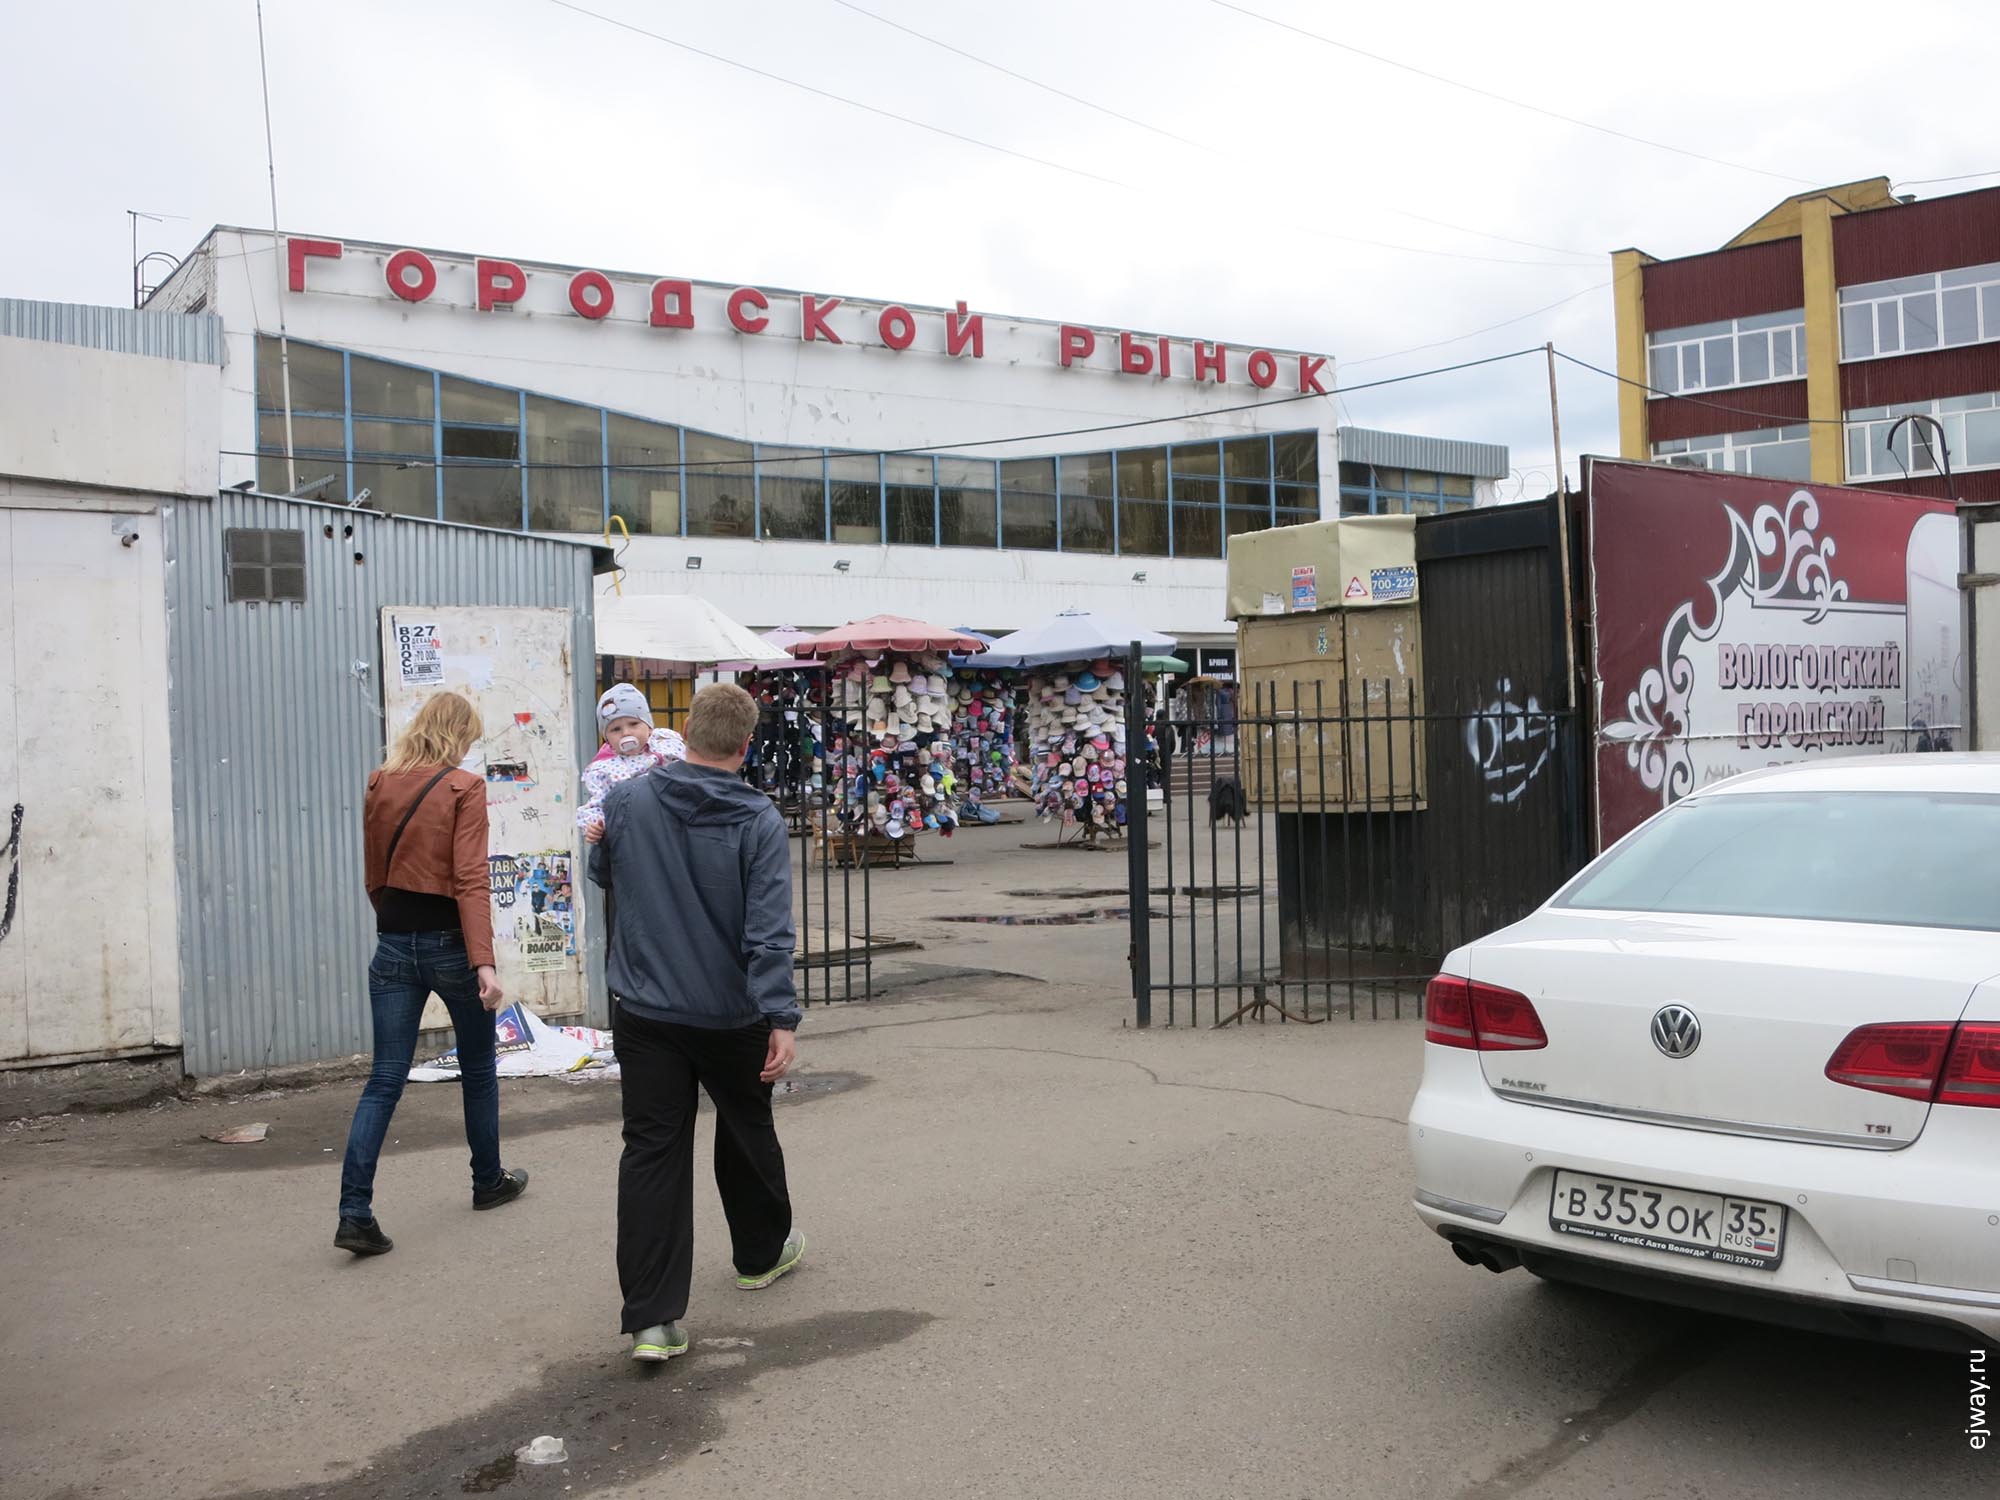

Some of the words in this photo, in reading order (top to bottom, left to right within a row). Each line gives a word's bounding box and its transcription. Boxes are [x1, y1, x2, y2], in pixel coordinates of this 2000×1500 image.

[286, 235, 984, 359] ГОРОДСКОЙ
[1059, 323, 1328, 395] РЫНОК
[1372, 577, 1415, 591] 700-222
[413, 625, 436, 637] 27
[400, 626, 413, 675] ВОЛОСЫ
[1718, 640, 1901, 694] ВОЛОГОДСКИЙ
[1737, 695, 1885, 751] ГОРОДСКОЙ
[527, 941, 564, 954] ВОЛОСЫ
[1502, 1078, 1547, 1091] PASSAT
[1864, 1124, 1892, 1135] TSI
[1727, 1203, 1767, 1237] 35
[1724, 1233, 1753, 1247] RUS
[1645, 1239, 1667, 1250] Авто
[1735, 1254, 1764, 1267] 279-777
